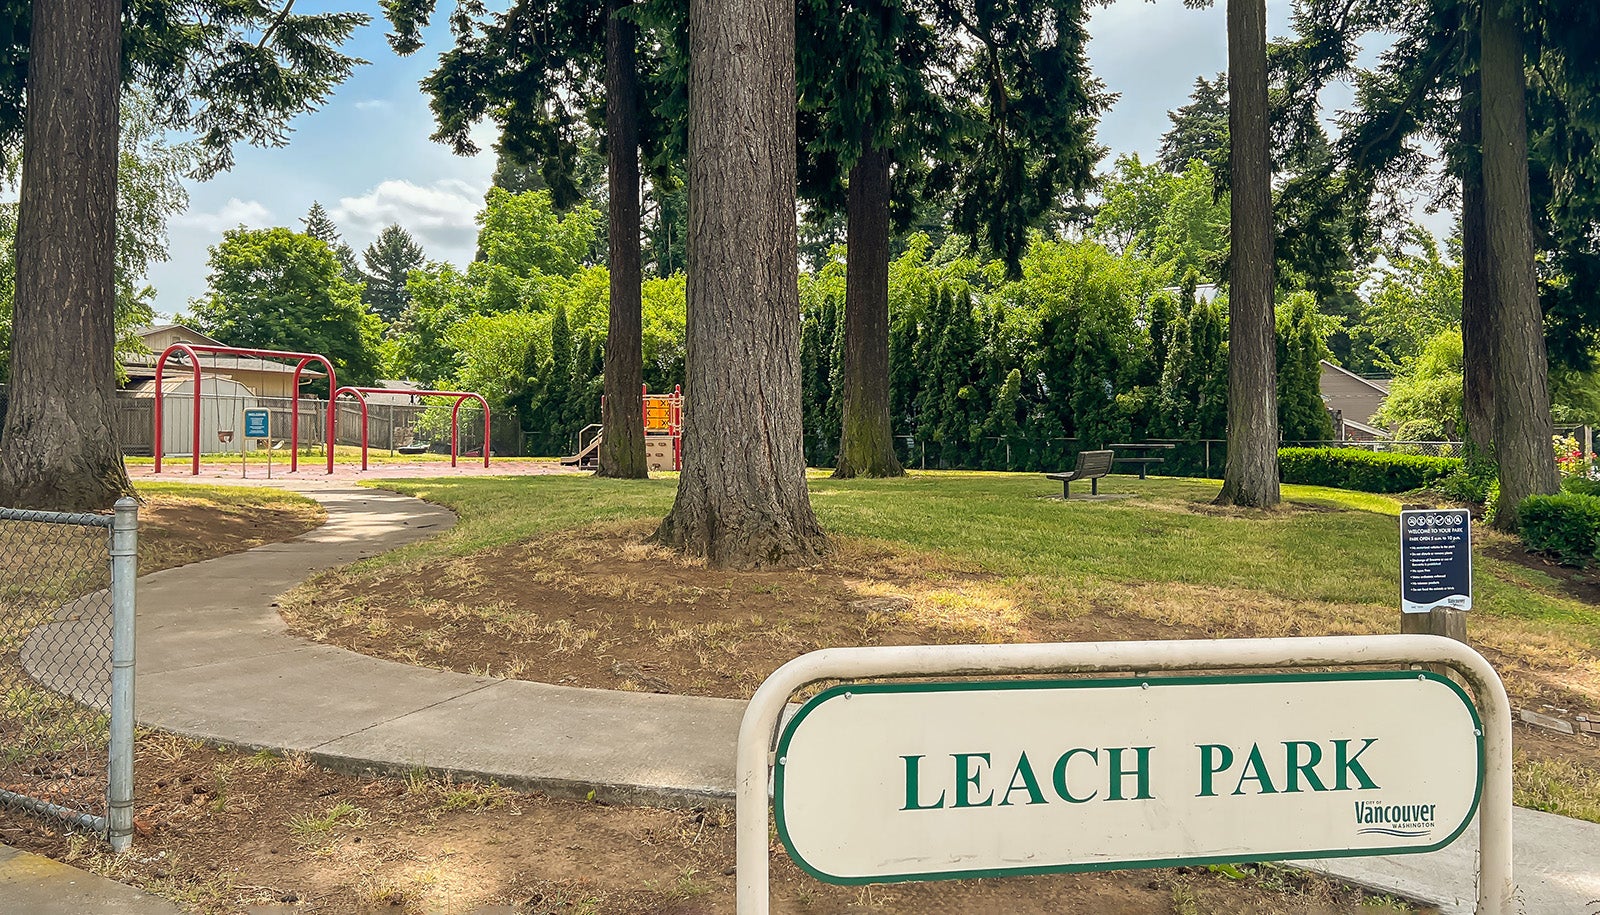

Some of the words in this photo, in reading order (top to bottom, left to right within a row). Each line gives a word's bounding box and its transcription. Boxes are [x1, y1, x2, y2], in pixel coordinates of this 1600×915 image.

[898, 746, 1156, 811] LEACH
[1194, 738, 1382, 797] PARK
[1354, 801, 1436, 824] Vancouver
